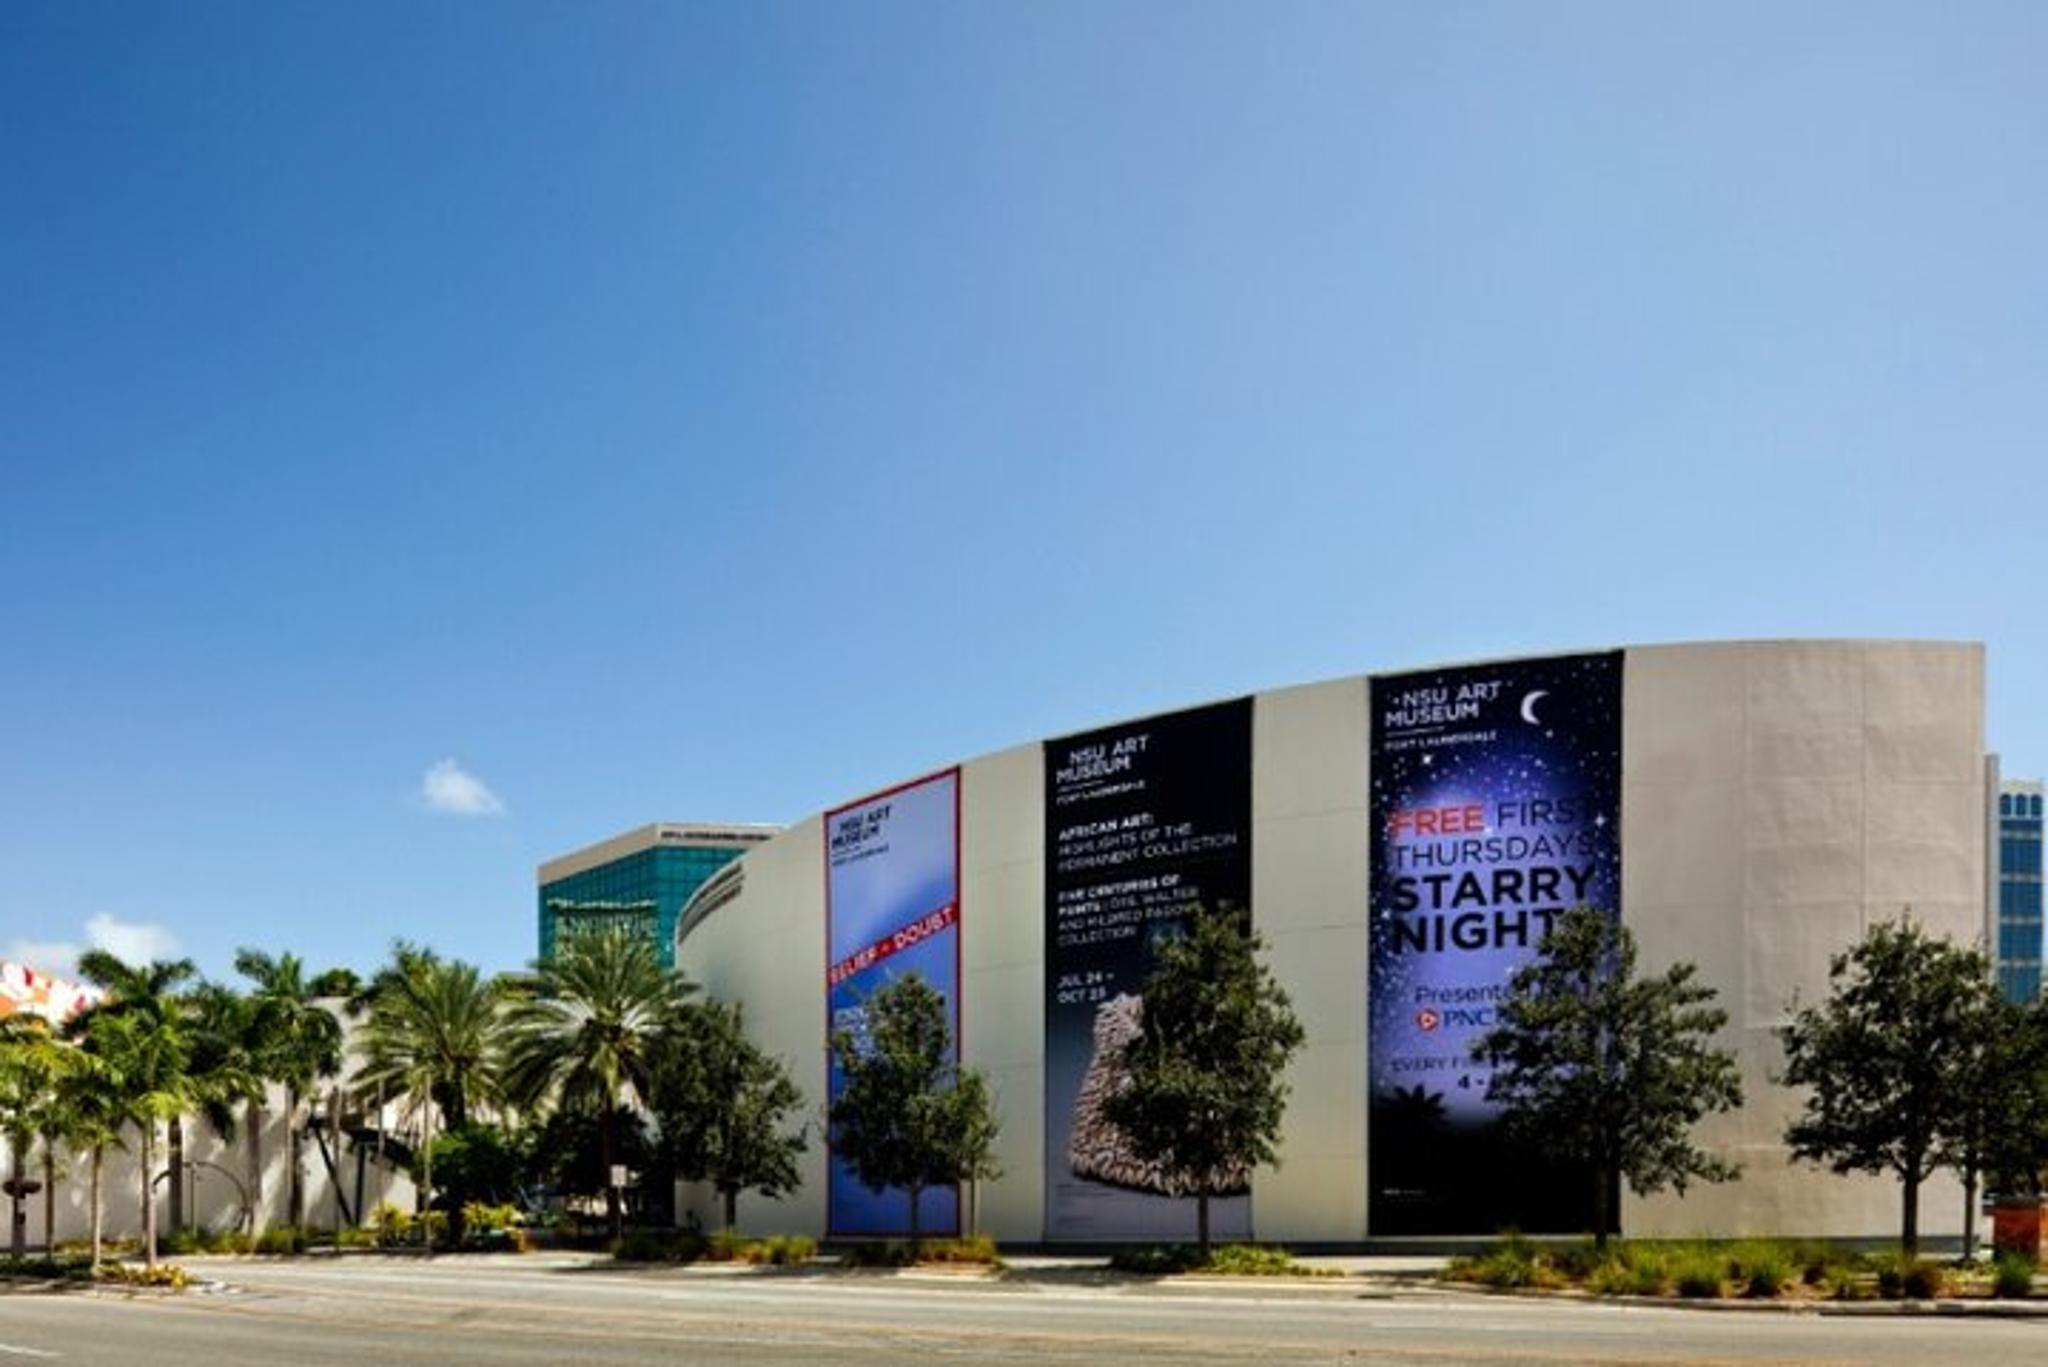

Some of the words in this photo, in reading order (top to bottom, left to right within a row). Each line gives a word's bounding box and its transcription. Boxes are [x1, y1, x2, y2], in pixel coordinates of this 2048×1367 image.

[1401, 687, 1448, 708] NSU
[1456, 681, 1502, 701] ART
[1385, 702, 1479, 728] MUSEUM
[1112, 734, 1149, 755] ART
[1056, 756, 1131, 784] MUSEUM
[1058, 820, 1118, 841] AFRICAN
[1140, 828, 1160, 842] OF
[1165, 822, 1193, 838] THE
[1387, 801, 1485, 838] FREE
[1395, 831, 1595, 869] THURSDAYS
[1393, 865, 1596, 913] STARRY
[893, 906, 952, 950] DOUBT
[1443, 1007, 1493, 1028] PNC
